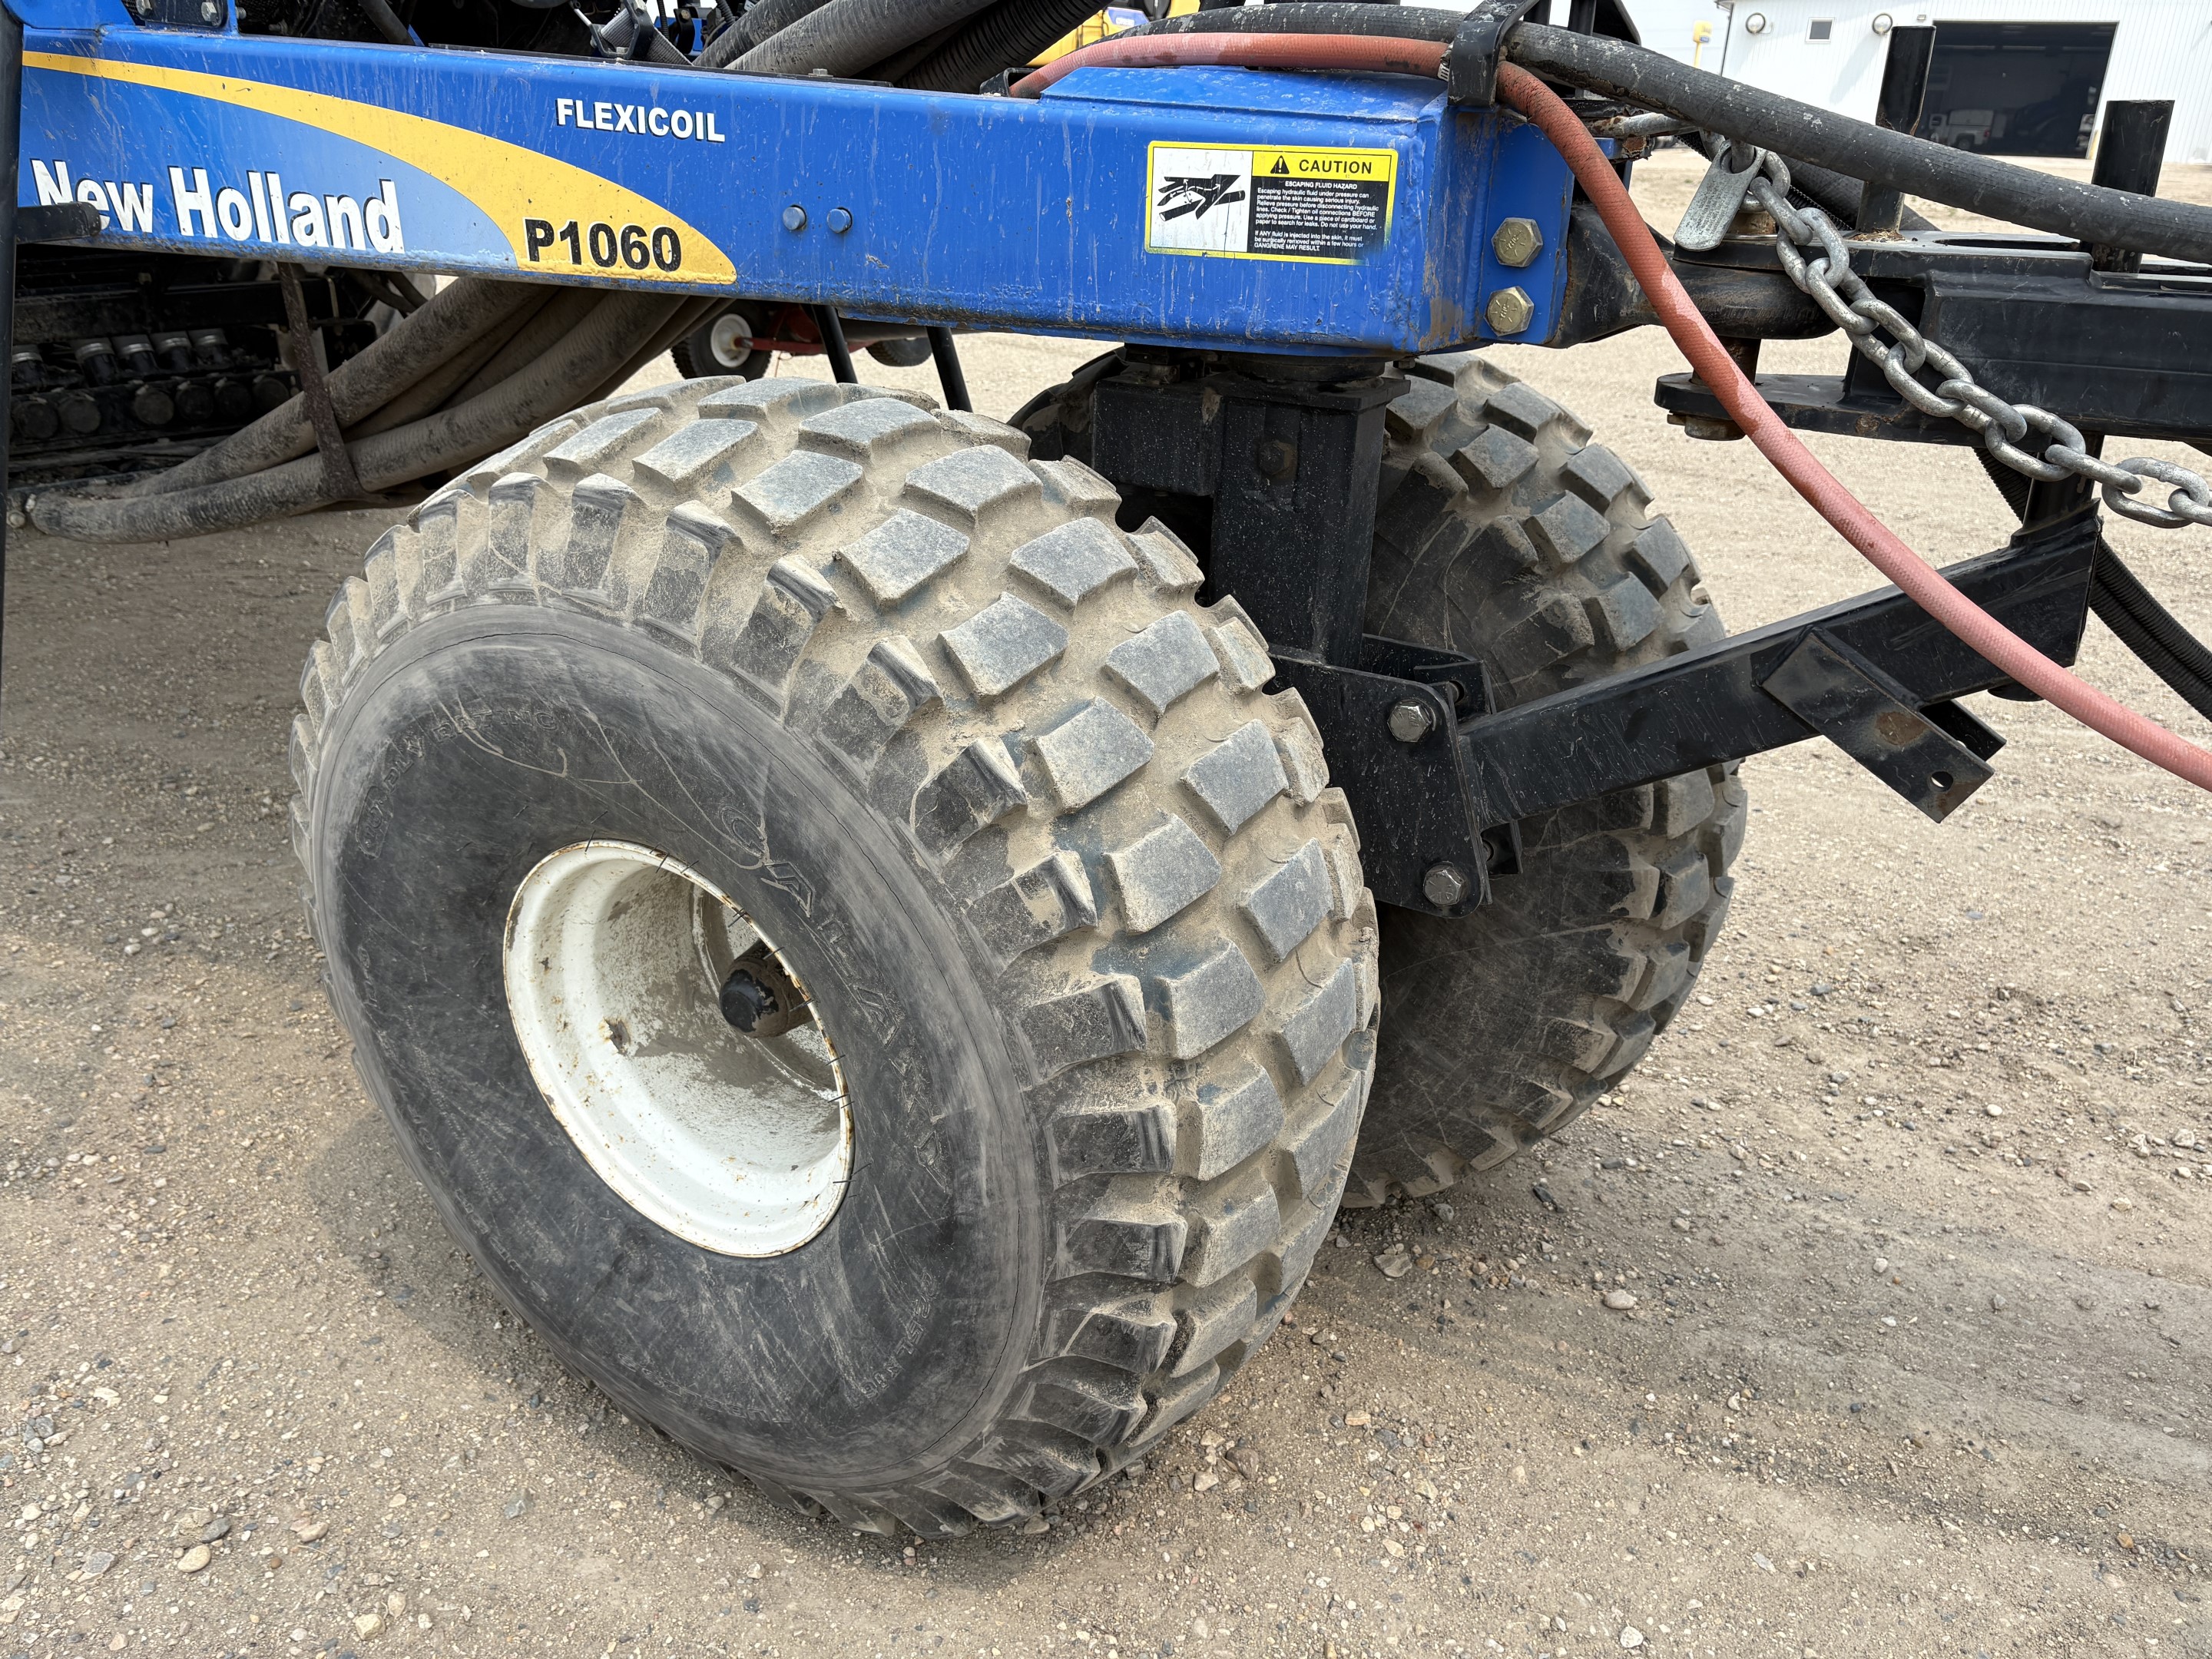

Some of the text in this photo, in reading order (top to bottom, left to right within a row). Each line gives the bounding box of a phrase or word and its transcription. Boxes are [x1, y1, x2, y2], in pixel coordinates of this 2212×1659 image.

[556, 98, 726, 144] FLEXICOIL
[1299, 159, 1372, 174] CAUTION
[30, 158, 406, 255] New Holland
[525, 218, 684, 273] P1060
[719, 806, 952, 1195] GALAXY
